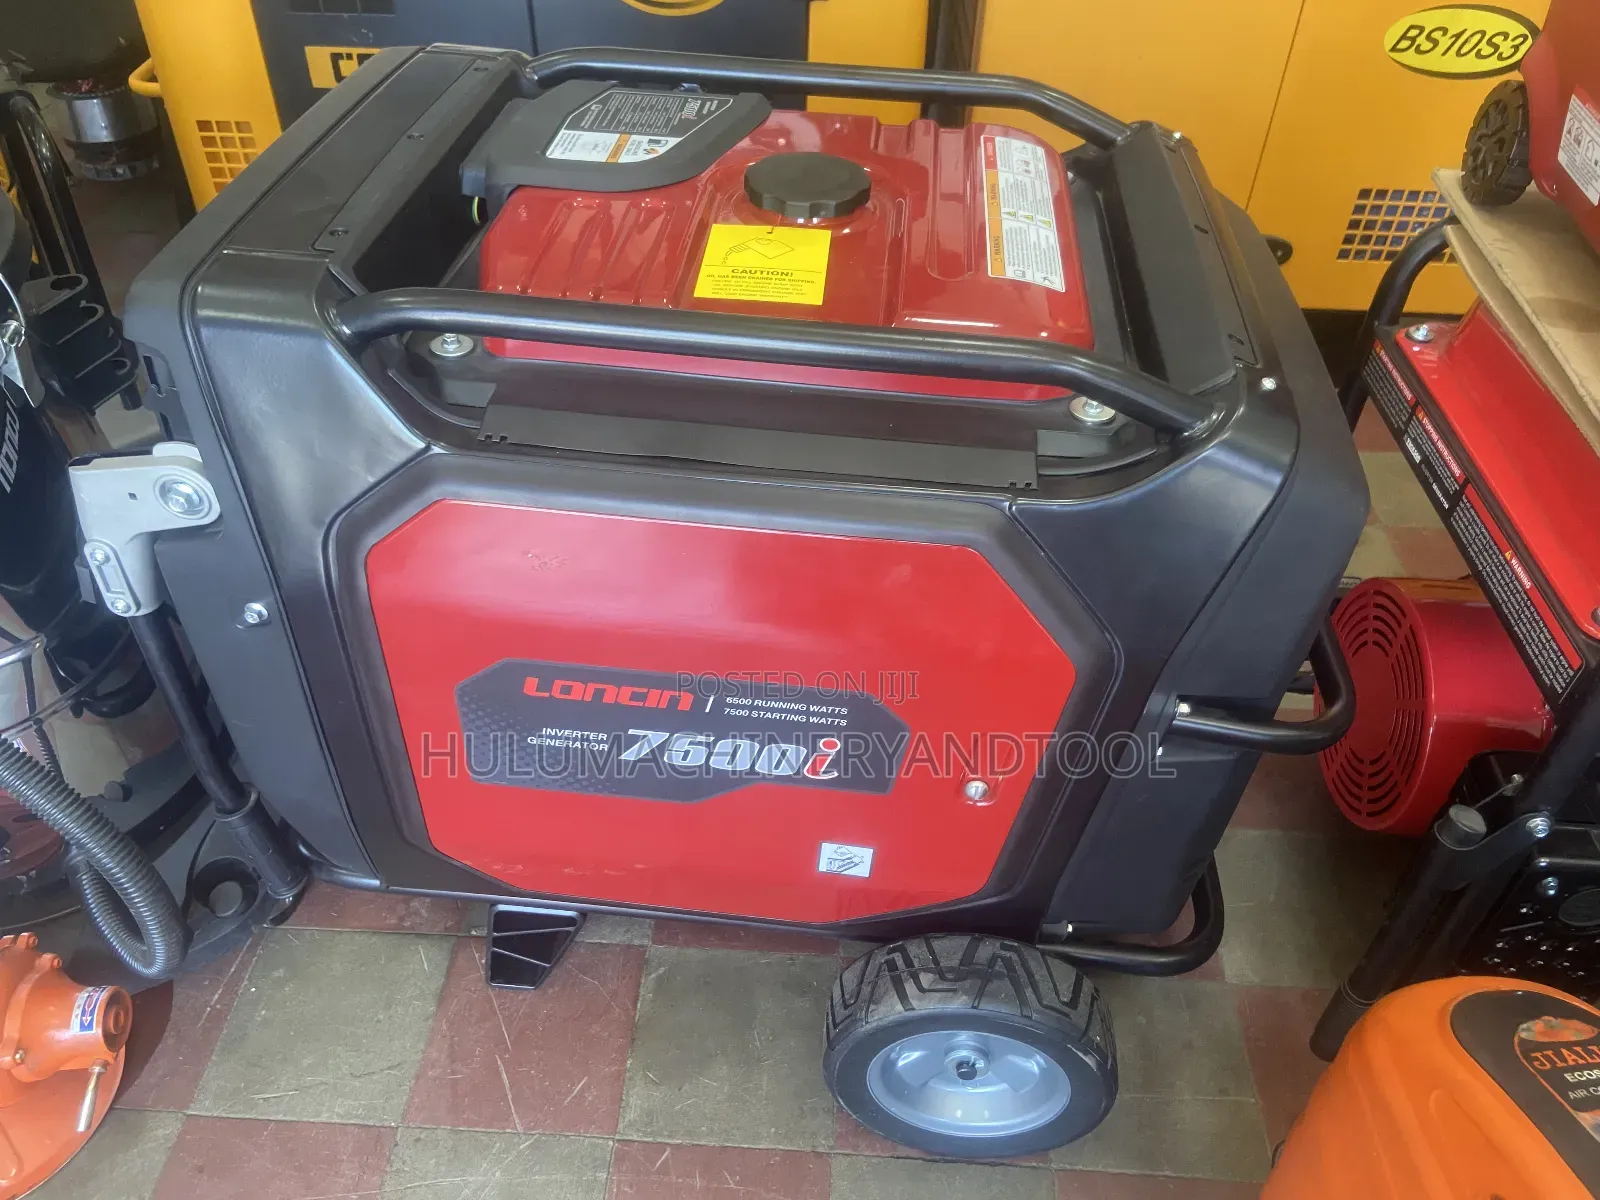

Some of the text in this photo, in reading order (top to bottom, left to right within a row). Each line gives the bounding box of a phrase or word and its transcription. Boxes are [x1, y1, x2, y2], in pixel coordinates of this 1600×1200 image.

[1388, 24, 1529, 61] BS10S3
[731, 268, 794, 278] CAUTION!
[1510, 557, 1532, 590] WARNING
[725, 696, 848, 715] 6500 RUNNING WATTS
[723, 707, 848, 727] 7500 STARTING WATTS
[527, 736, 609, 751] GENERATOR
[542, 727, 608, 741] INVERTER
[618, 728, 841, 779] 7500i
[1568, 1089, 1589, 1100] AIR
